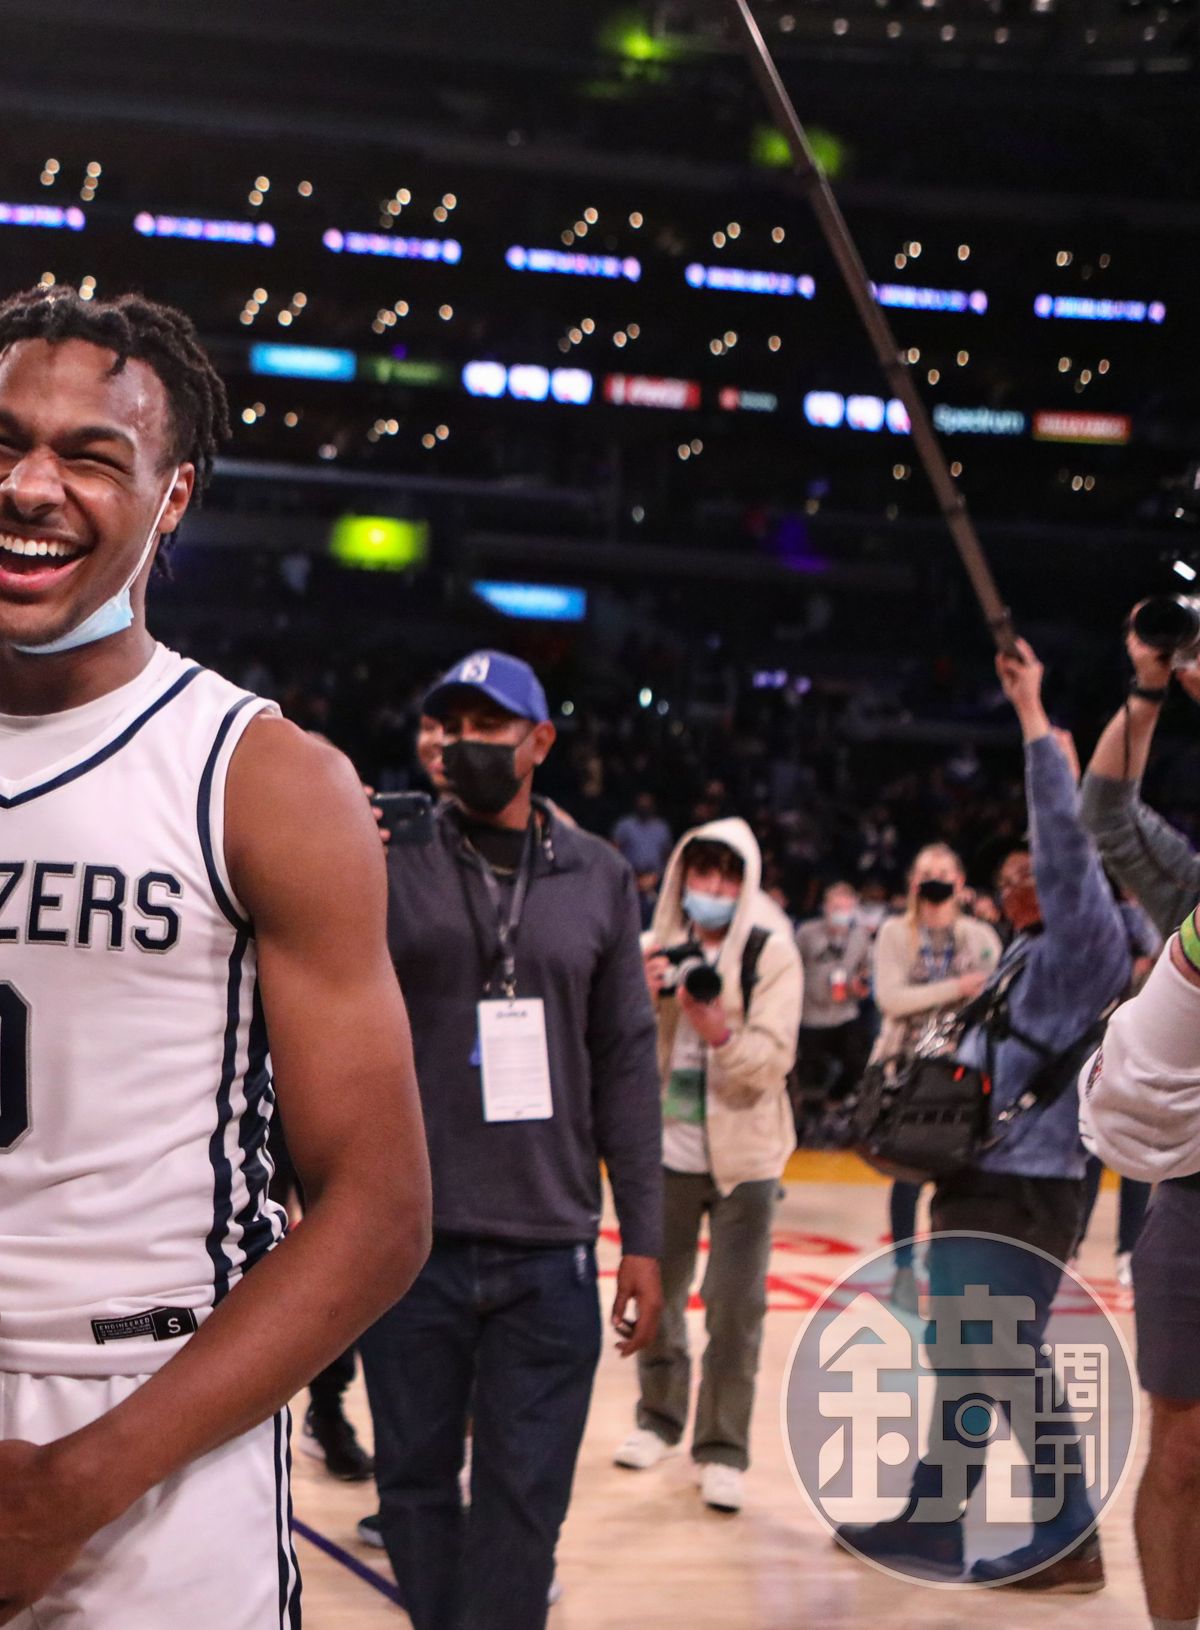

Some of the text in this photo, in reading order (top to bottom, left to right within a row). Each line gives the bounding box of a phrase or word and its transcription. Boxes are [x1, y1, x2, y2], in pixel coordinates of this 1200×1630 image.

[933, 404, 1025, 435] Spectrum
[99, 1317, 150, 1330] ENGINEERED
[167, 1317, 181, 1334] S
